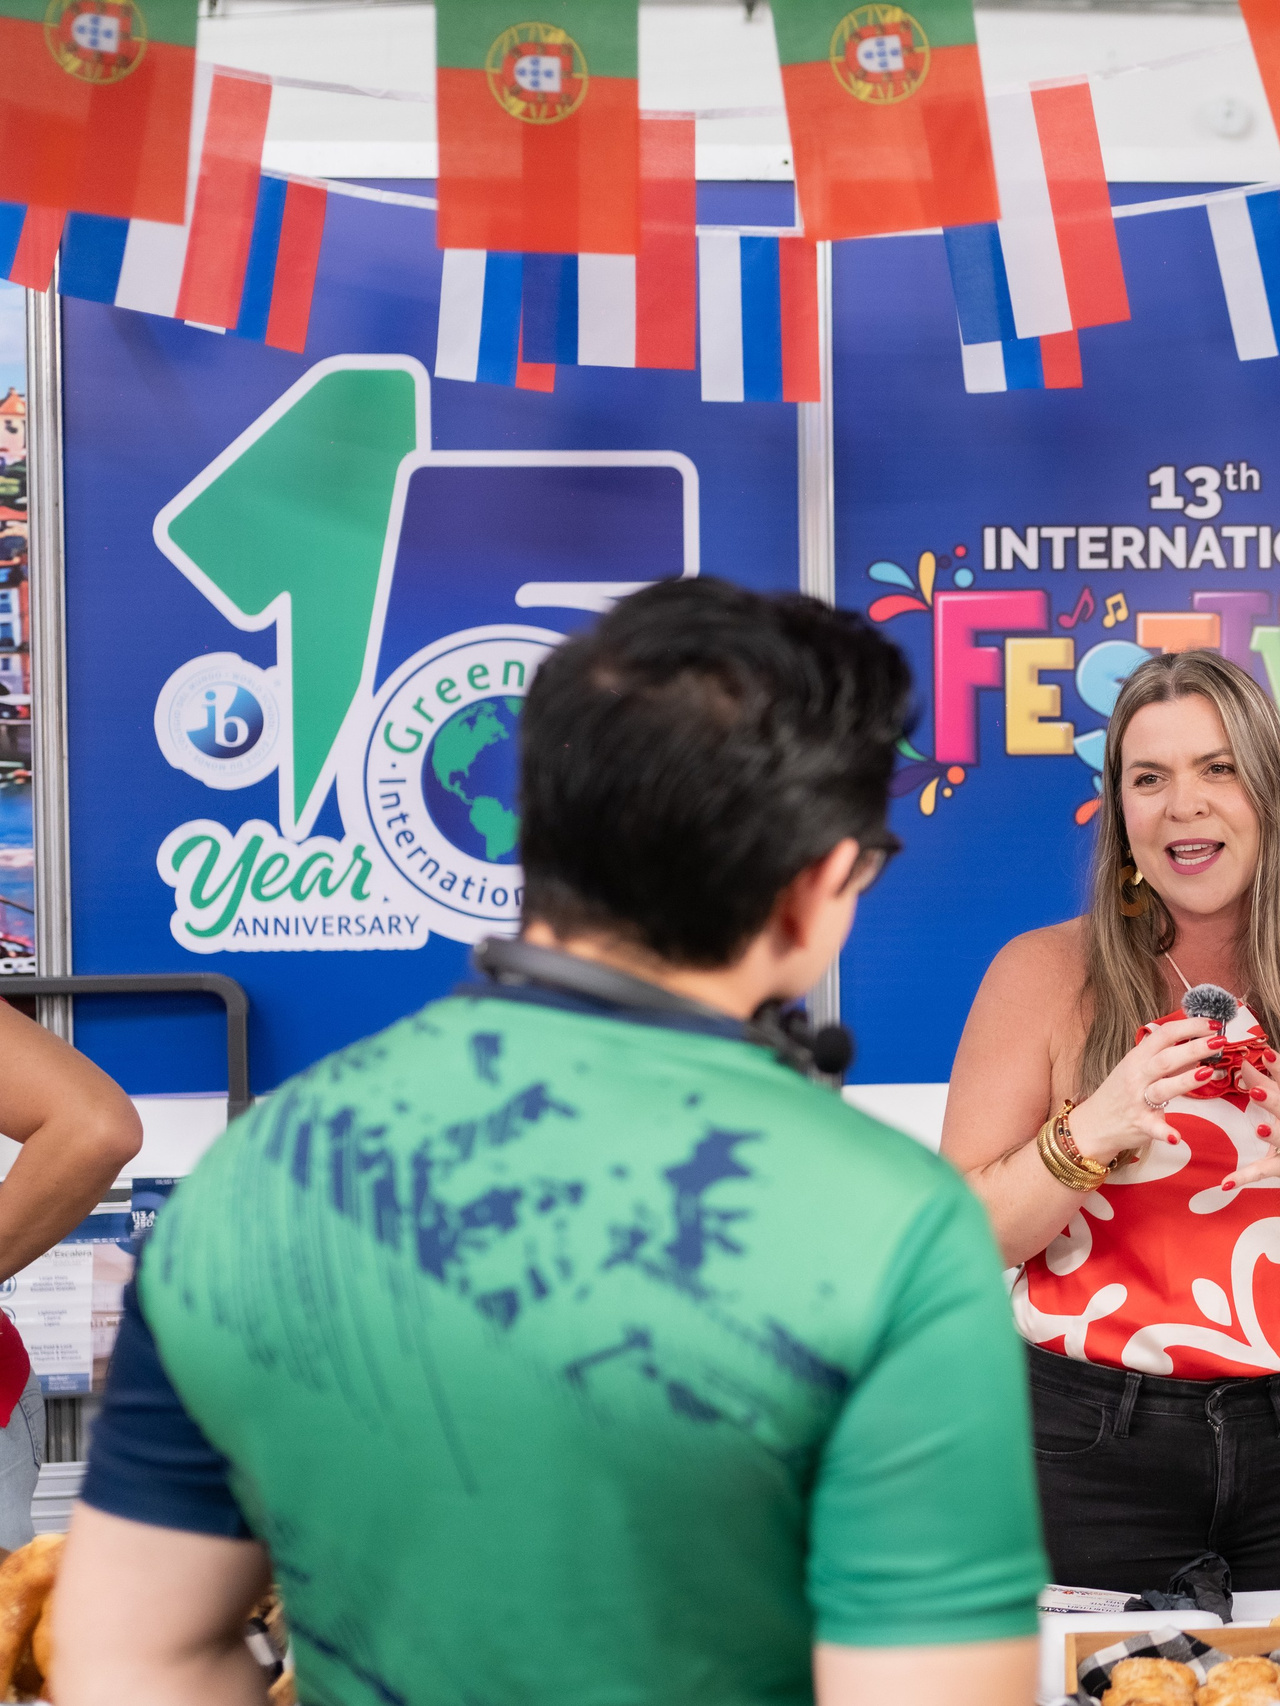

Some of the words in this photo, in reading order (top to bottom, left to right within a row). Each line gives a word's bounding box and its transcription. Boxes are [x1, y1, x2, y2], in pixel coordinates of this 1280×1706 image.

[1149, 463, 1261, 519] 13th
[383, 659, 526, 754] Green
[171, 834, 373, 938] Year
[232, 914, 420, 938] ANNIVERSARY
